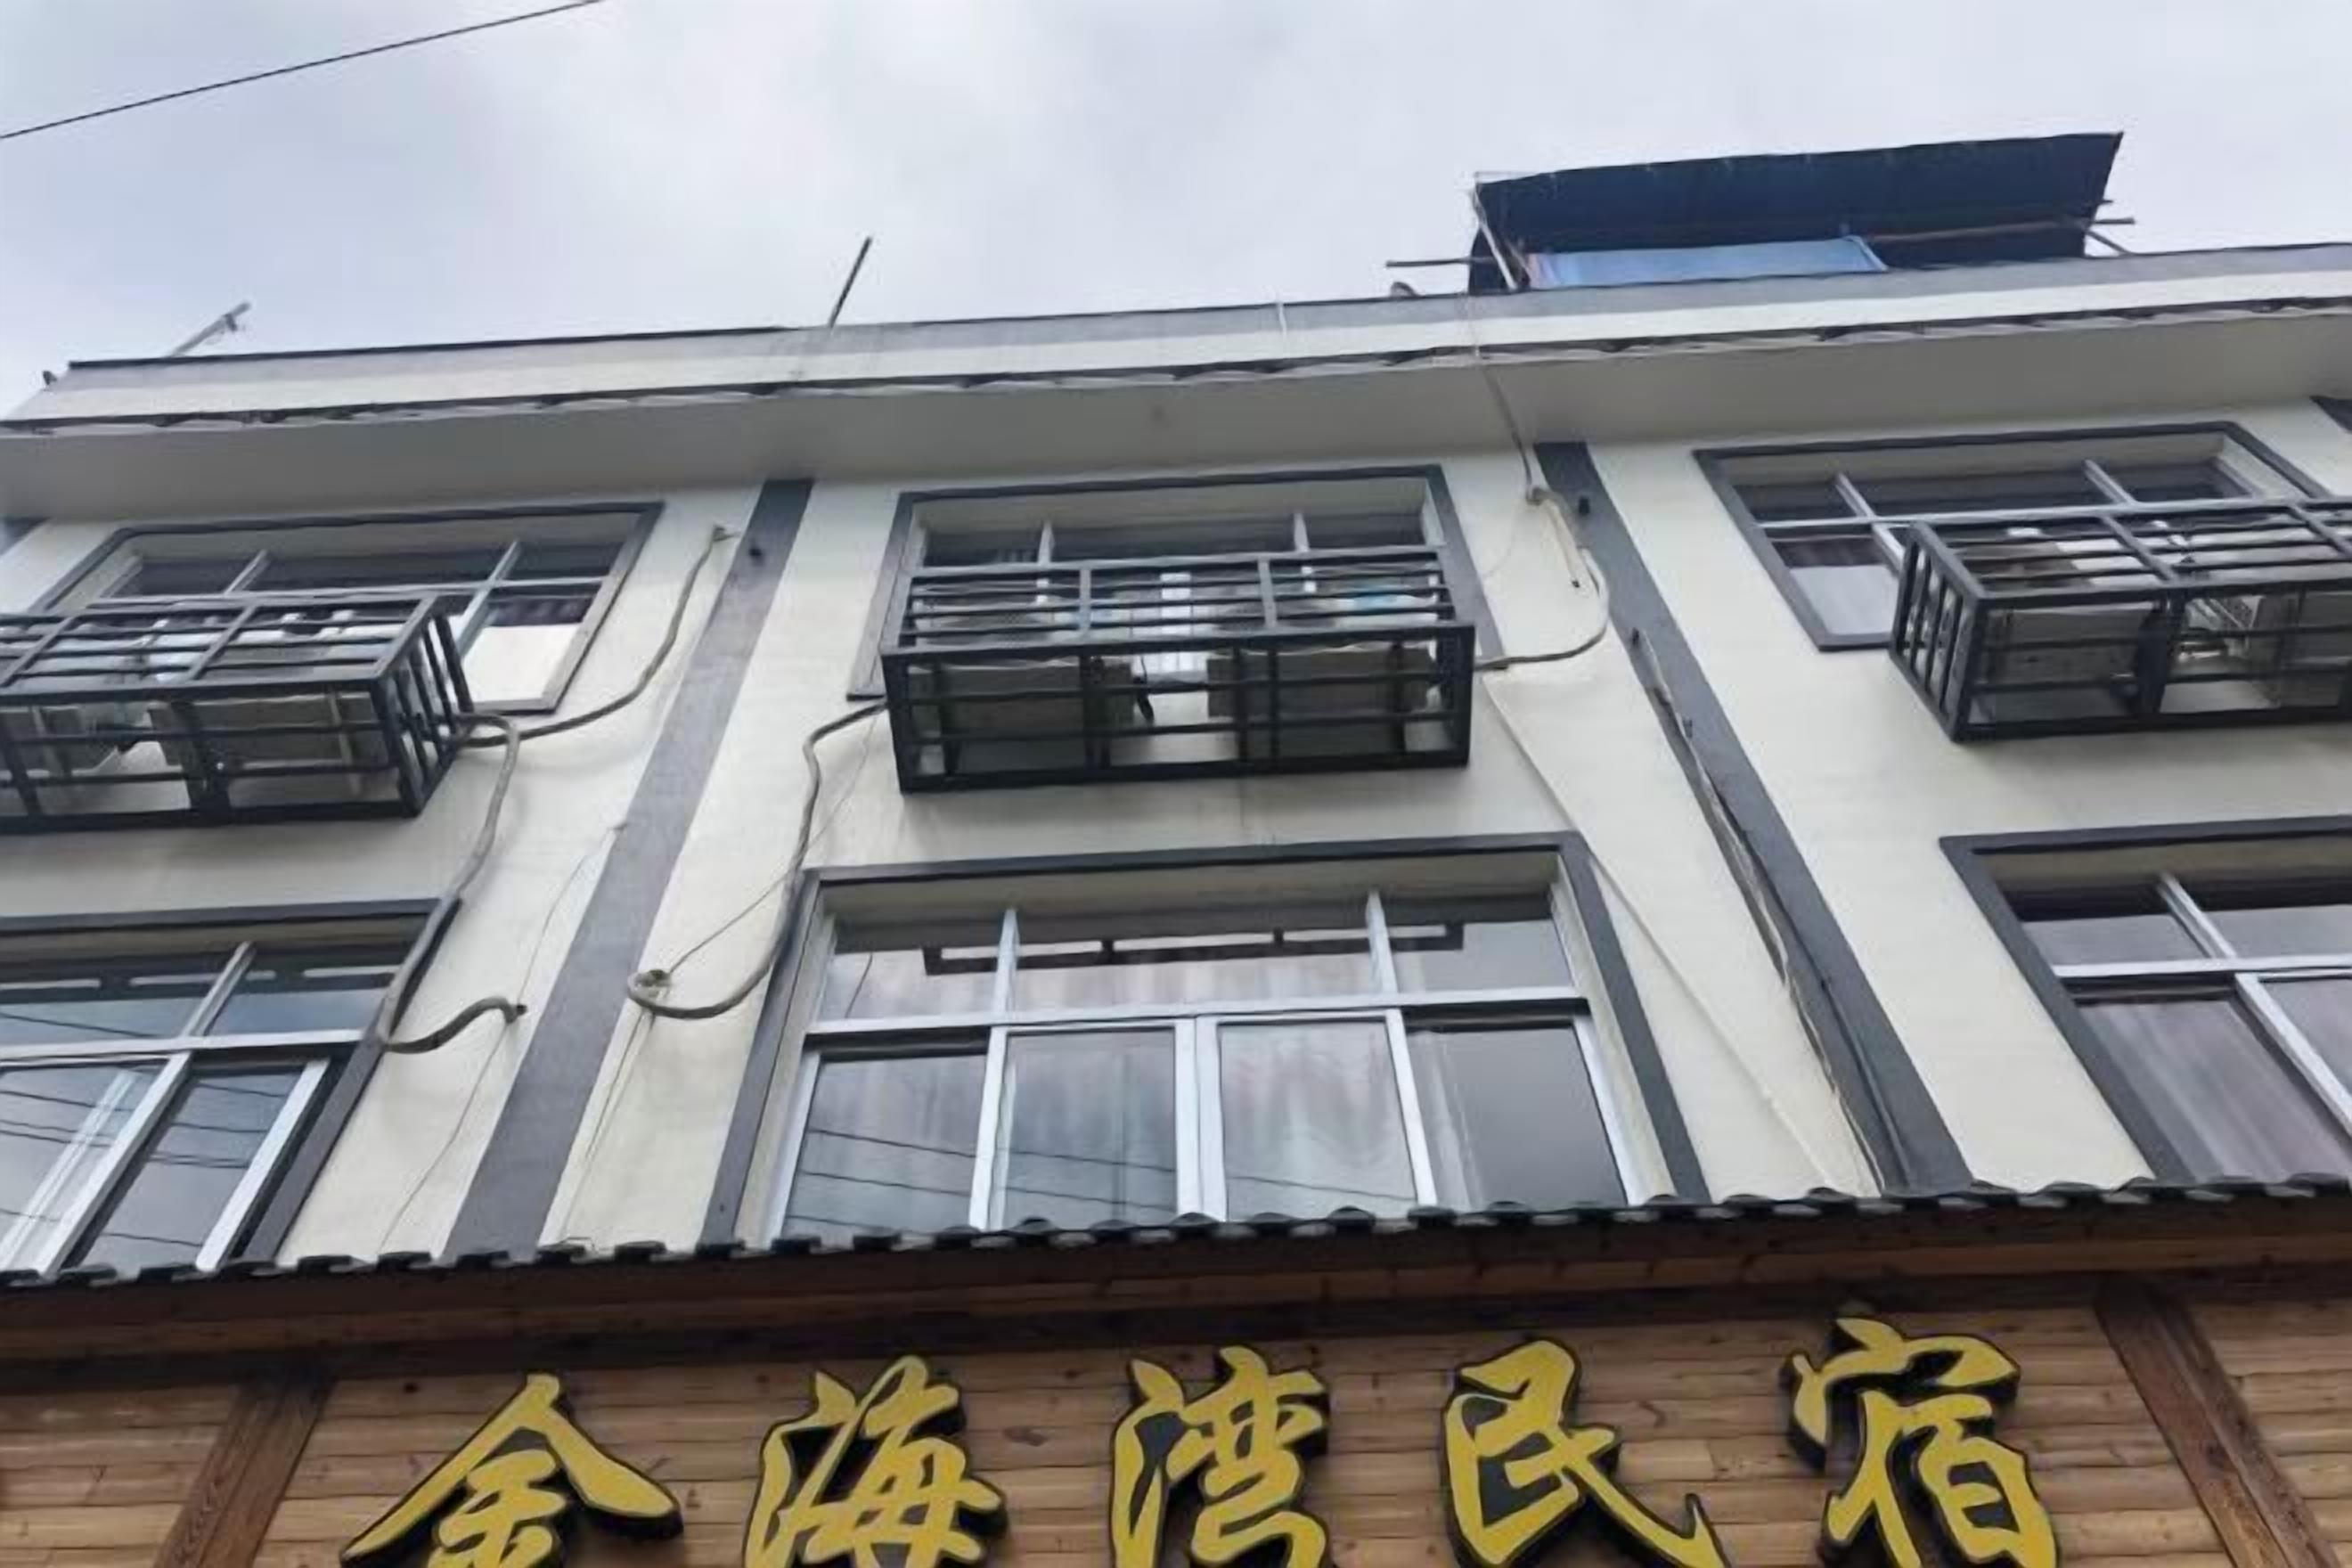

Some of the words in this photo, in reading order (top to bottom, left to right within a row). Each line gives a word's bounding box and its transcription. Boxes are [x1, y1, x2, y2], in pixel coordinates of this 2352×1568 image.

[346, 1317, 2058, 1568] 金海湾民宿
